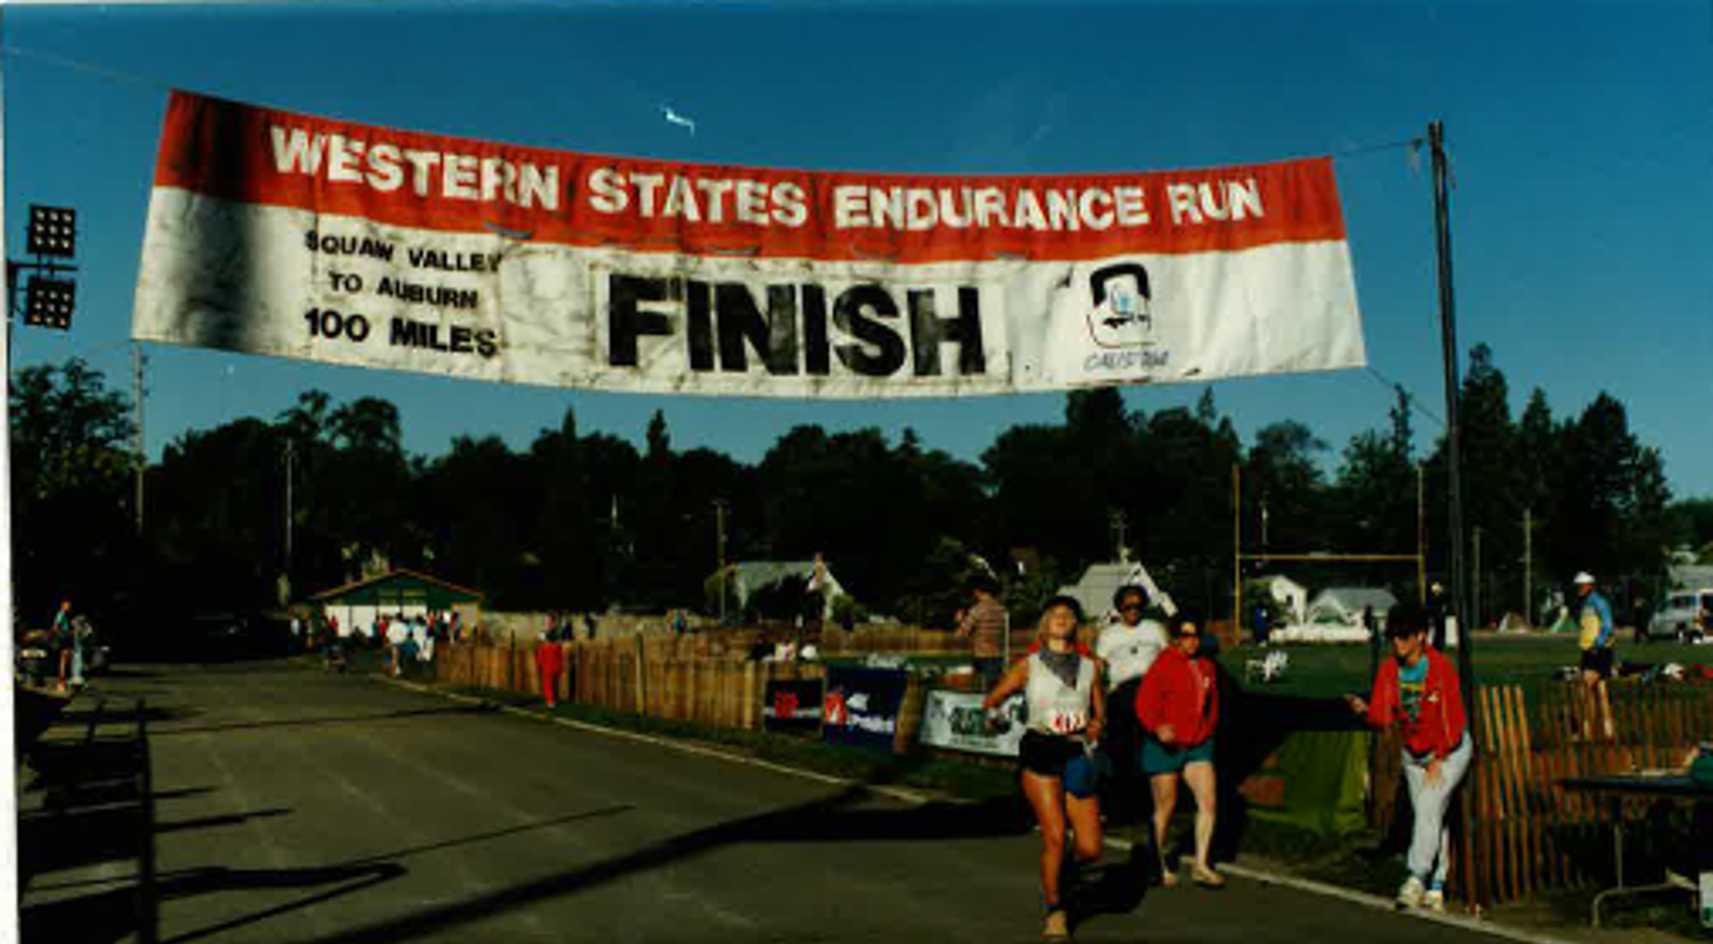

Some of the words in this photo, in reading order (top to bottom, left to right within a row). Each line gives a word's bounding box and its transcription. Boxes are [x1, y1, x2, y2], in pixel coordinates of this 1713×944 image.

[271, 126, 559, 210] WESTERN
[588, 168, 808, 228] STATES
[832, 185, 1149, 231] ENDURANCE
[1167, 180, 1263, 225] RUN
[304, 229, 394, 263] SQUAW
[408, 245, 503, 273] VALLEY
[328, 272, 362, 294] TO
[376, 277, 479, 310] AUBURN
[304, 308, 370, 343] 100
[389, 317, 499, 359] MILES
[607, 273, 988, 378] FINISH
